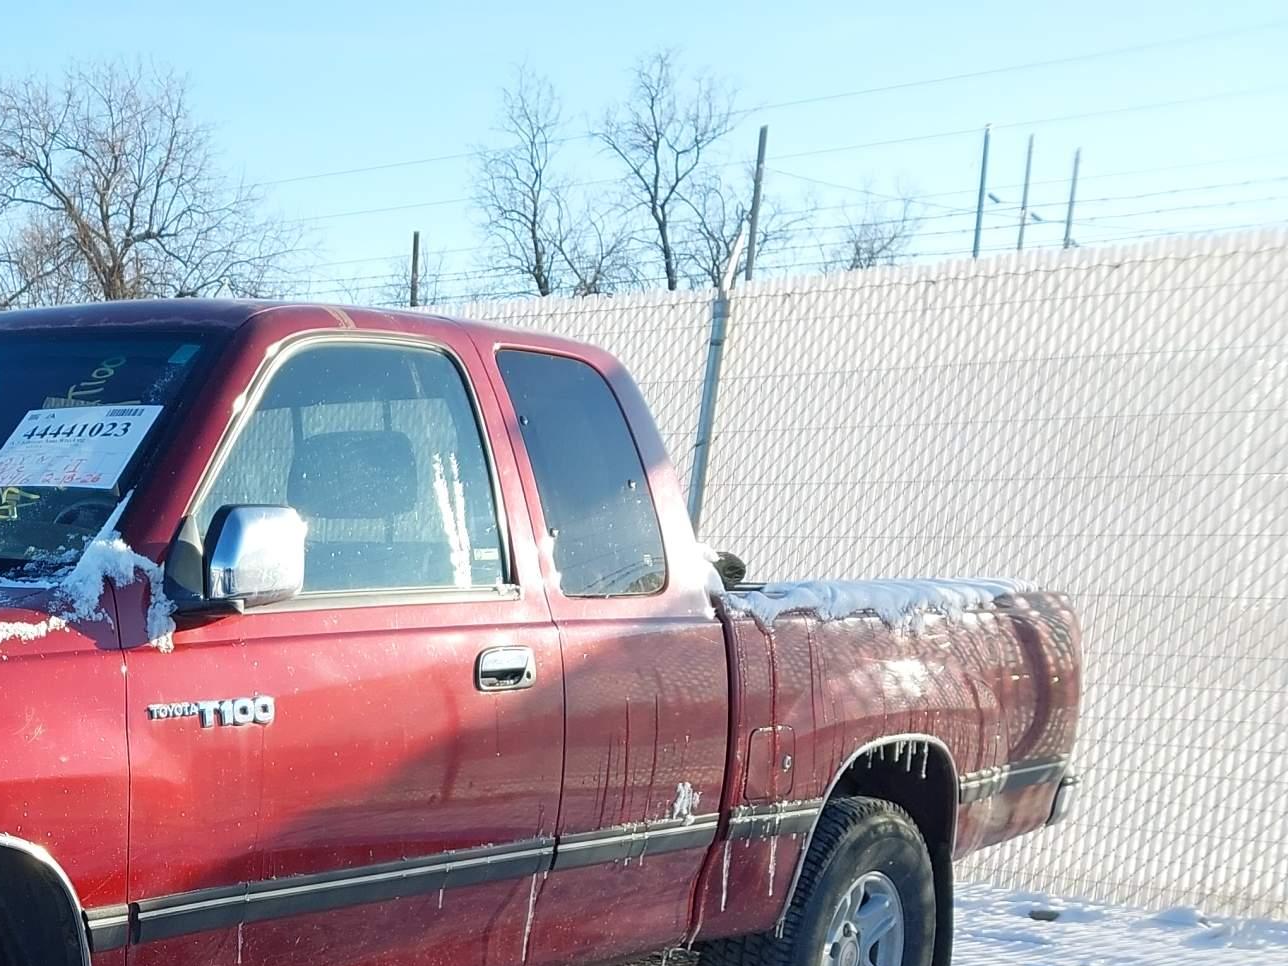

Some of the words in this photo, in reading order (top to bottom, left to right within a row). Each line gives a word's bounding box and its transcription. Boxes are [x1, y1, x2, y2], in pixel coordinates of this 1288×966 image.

[23, 422, 132, 440] 44441023
[146, 702, 200, 720] TOYOTA
[199, 695, 276, 729] T100
